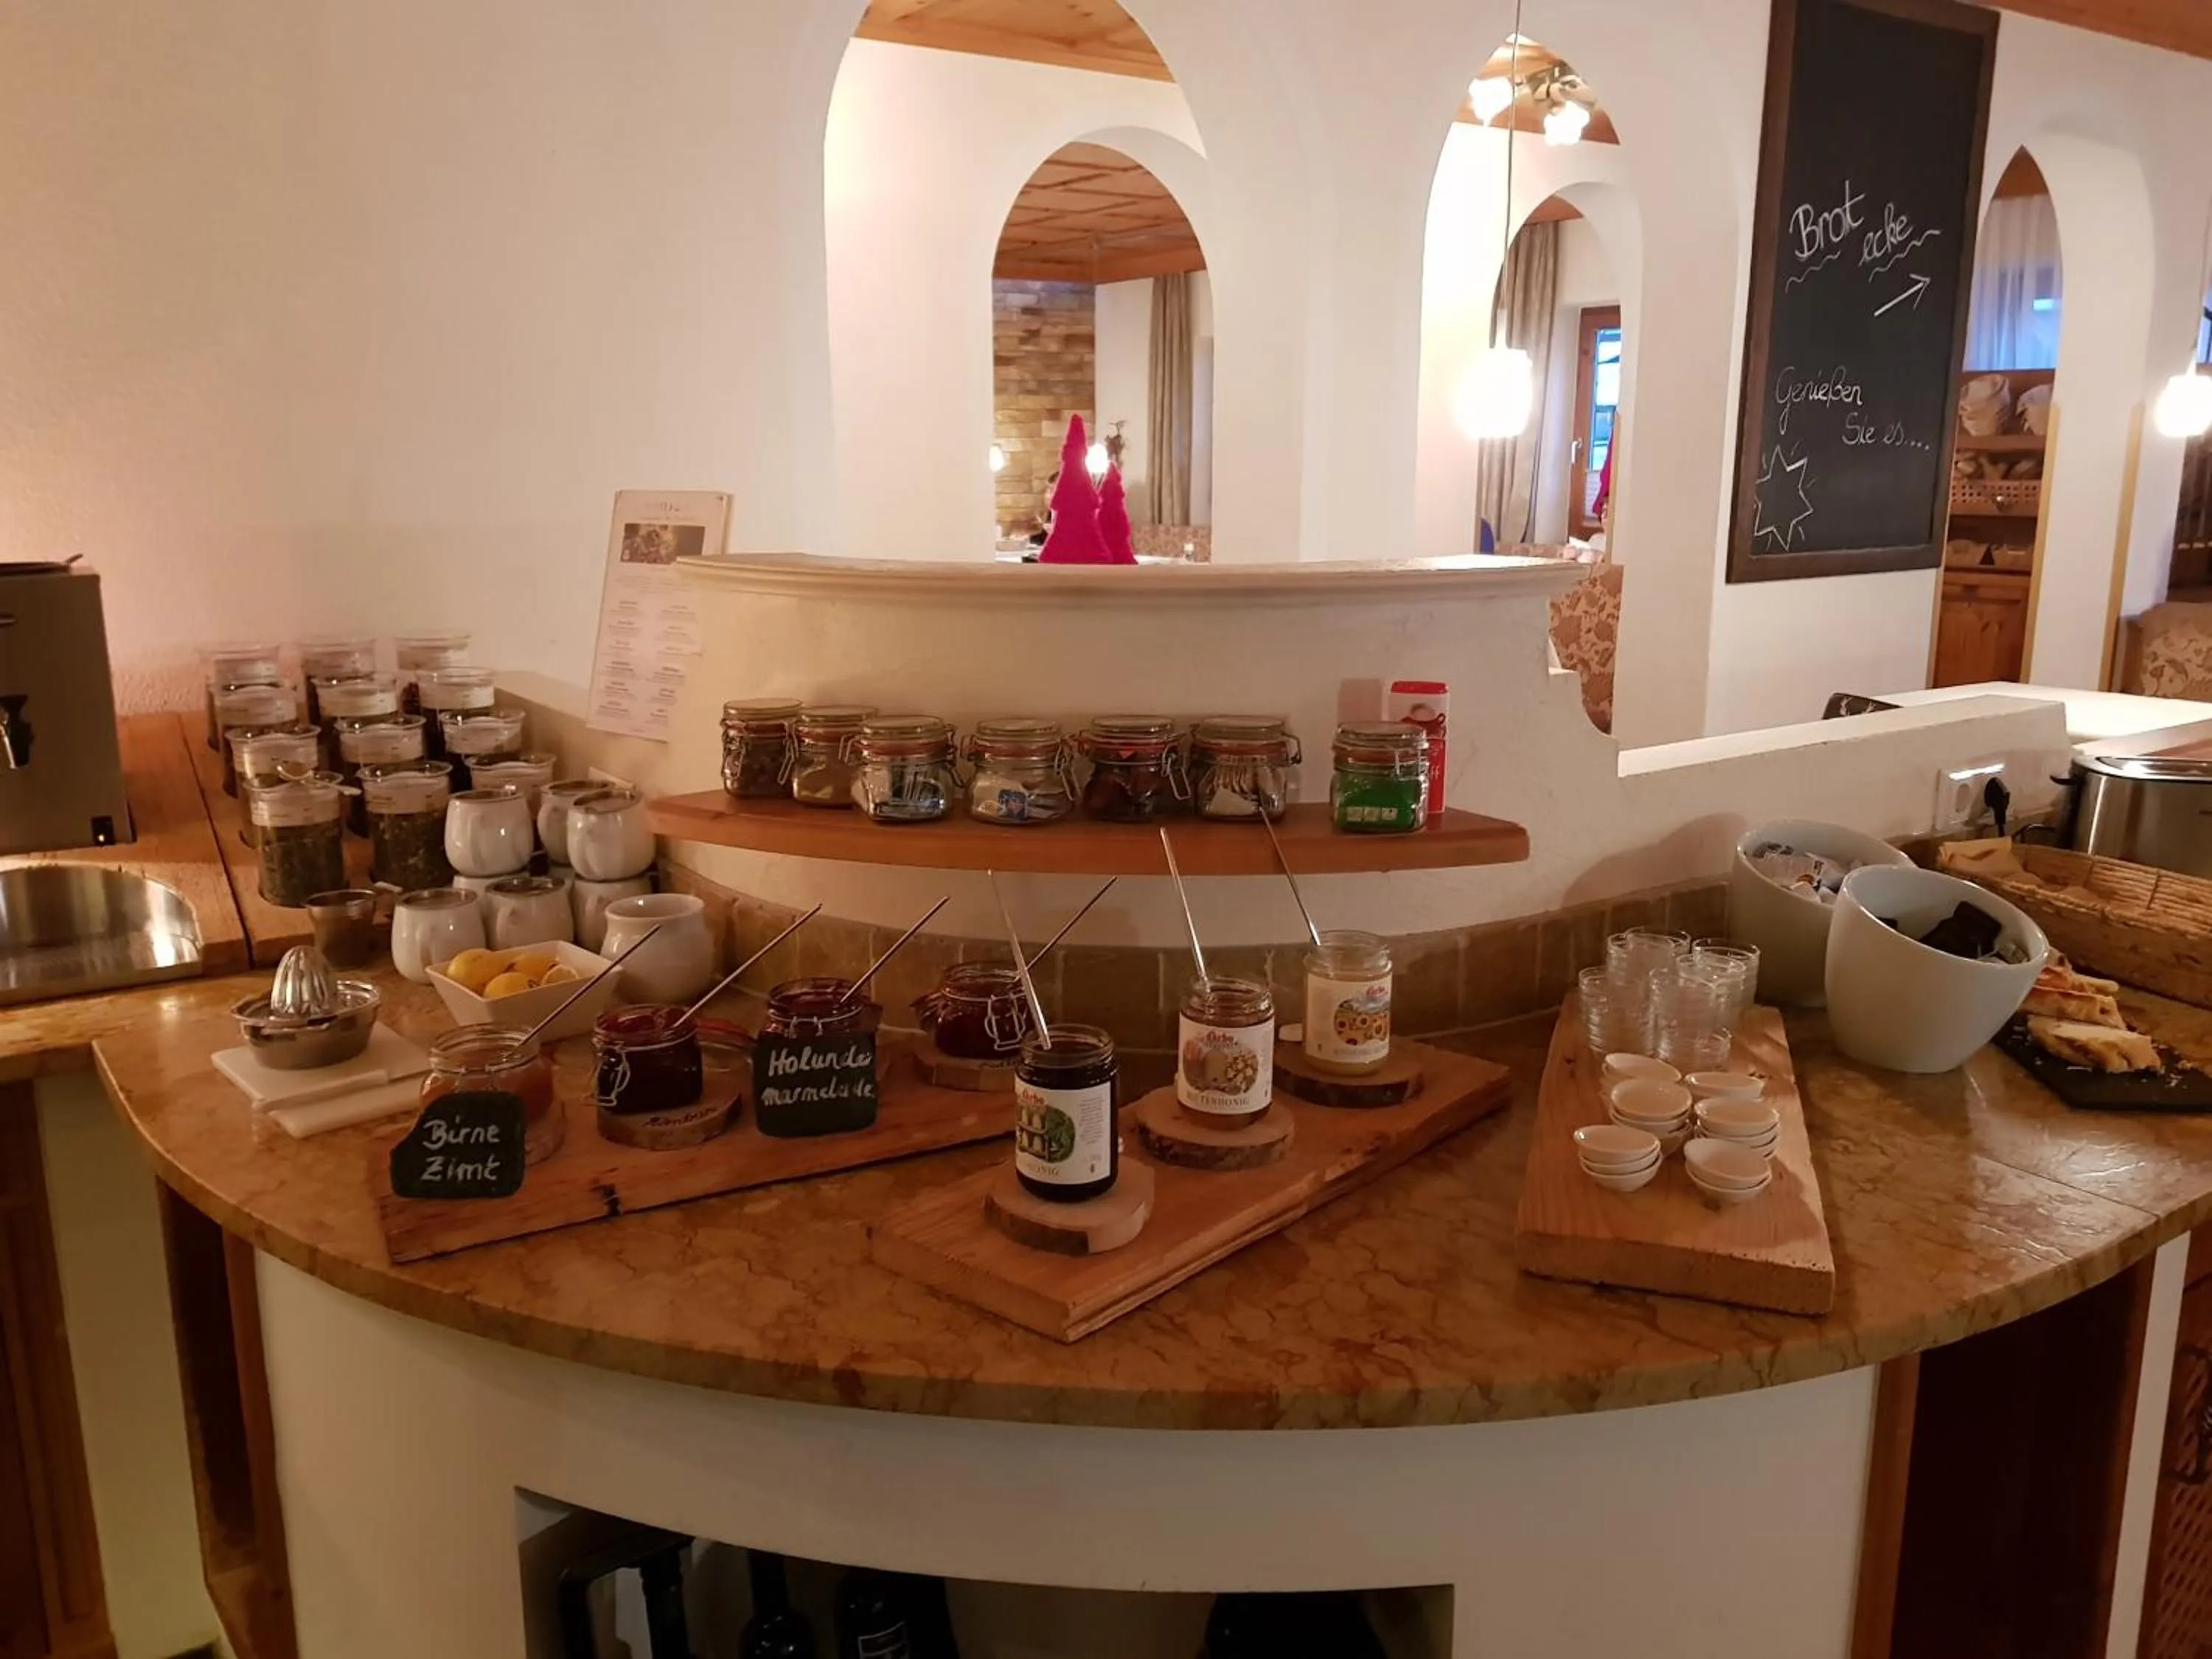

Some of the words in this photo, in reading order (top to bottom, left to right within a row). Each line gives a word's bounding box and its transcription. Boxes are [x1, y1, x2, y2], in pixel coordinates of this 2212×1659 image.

[1789, 179, 1866, 262] Brot
[1857, 201, 1914, 267] ecke
[1775, 366, 1863, 436] Genießen
[1842, 412, 1877, 445] Sie
[422, 1114, 501, 1150] Birne
[420, 1152, 501, 1181] Zimt
